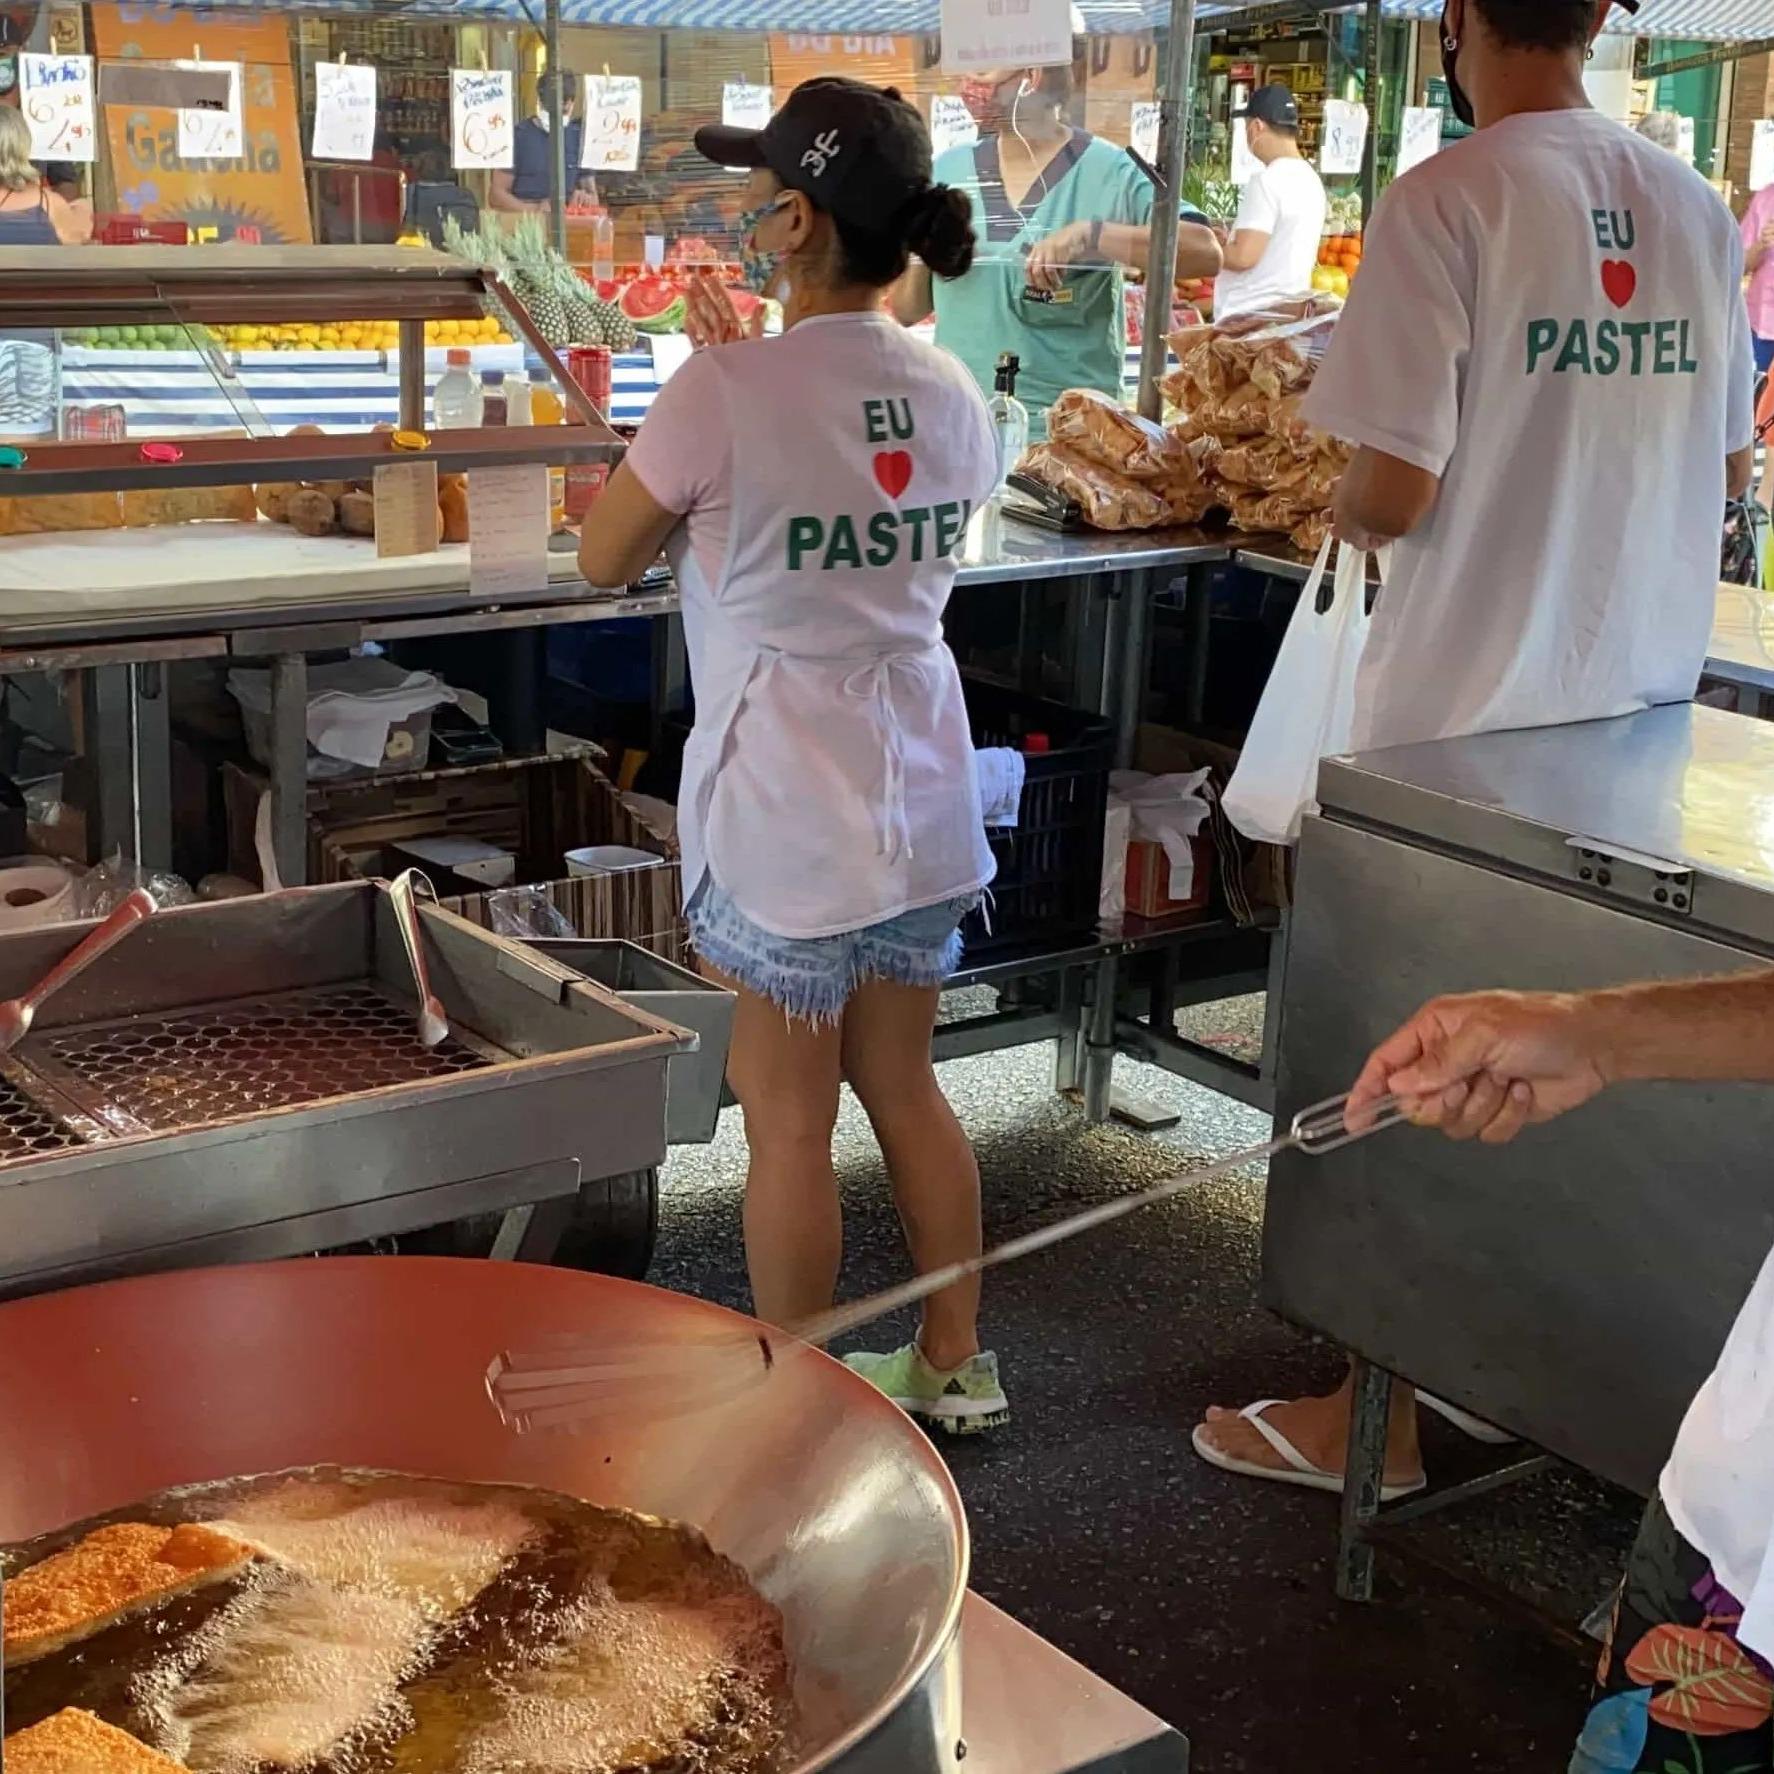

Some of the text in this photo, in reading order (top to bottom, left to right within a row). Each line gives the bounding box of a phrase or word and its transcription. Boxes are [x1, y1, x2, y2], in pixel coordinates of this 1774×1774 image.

[1591, 208, 1636, 251] EU
[1526, 317, 1698, 376] PASTEL
[862, 397, 914, 443] EU
